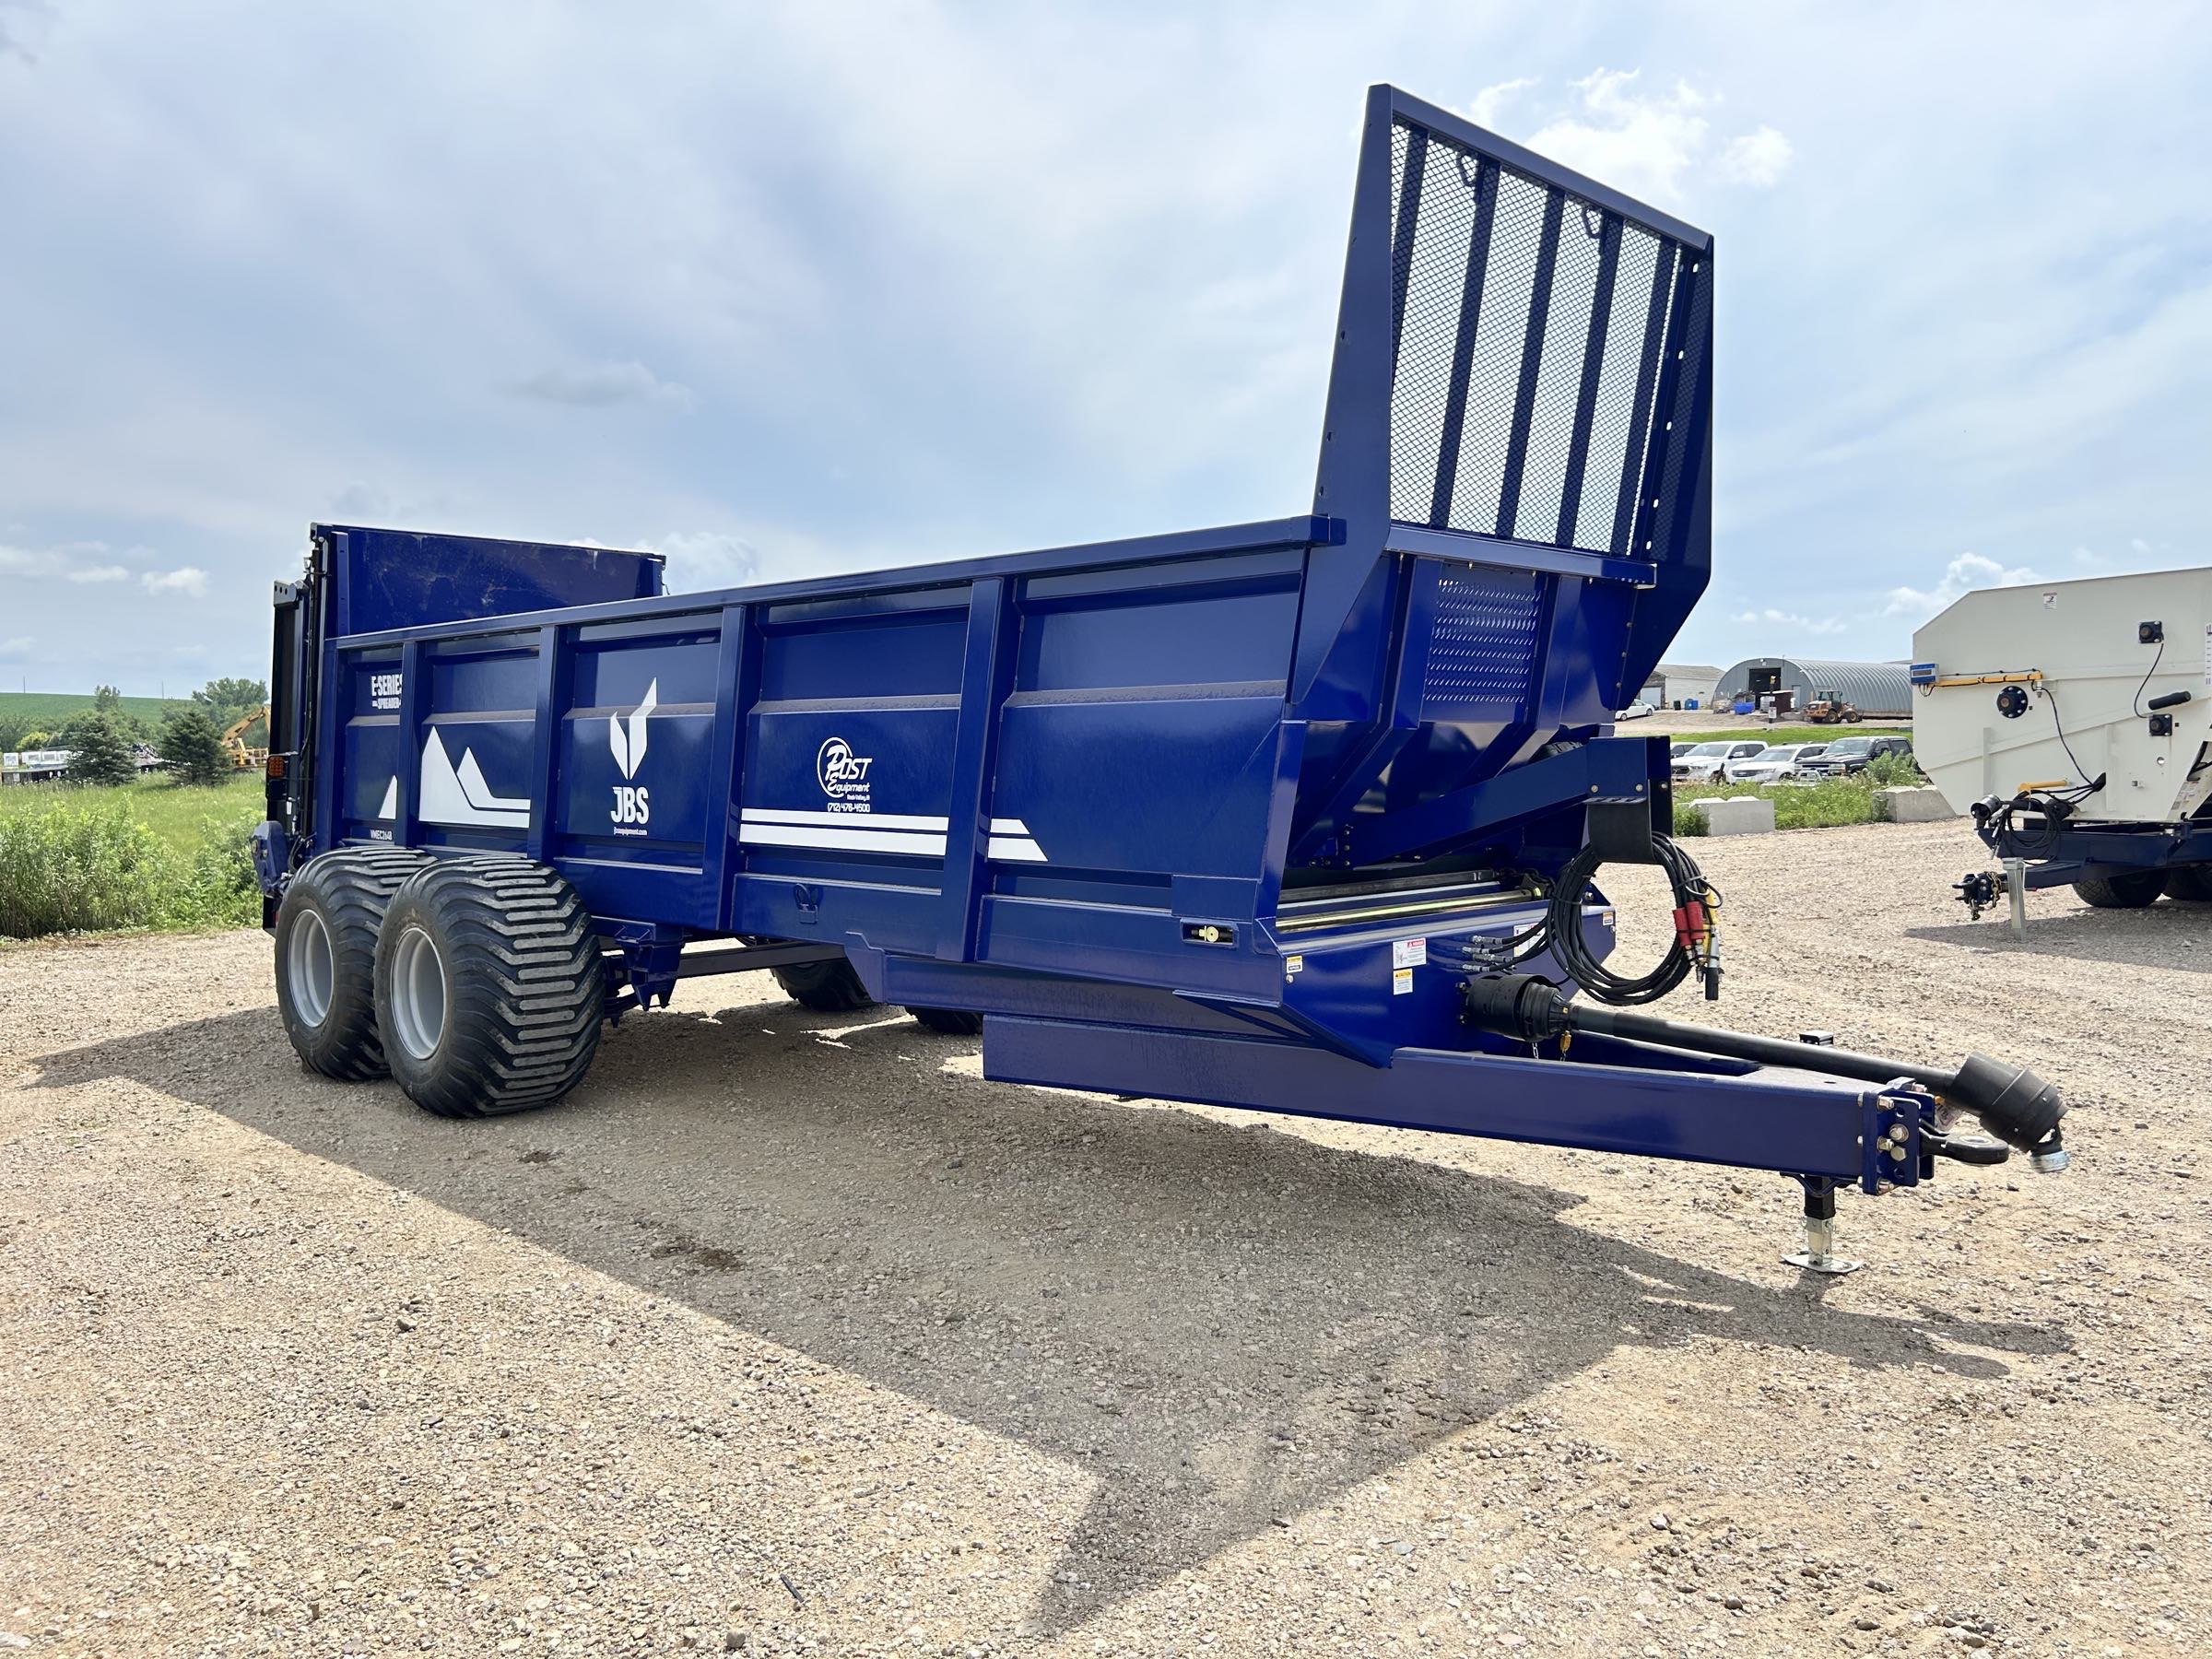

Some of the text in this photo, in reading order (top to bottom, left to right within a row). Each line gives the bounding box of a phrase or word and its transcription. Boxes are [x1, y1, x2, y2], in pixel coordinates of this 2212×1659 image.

[827, 772, 871, 794] Equipment
[610, 786, 650, 824] JBS
[827, 802, 871, 813] (712) 476-4500
